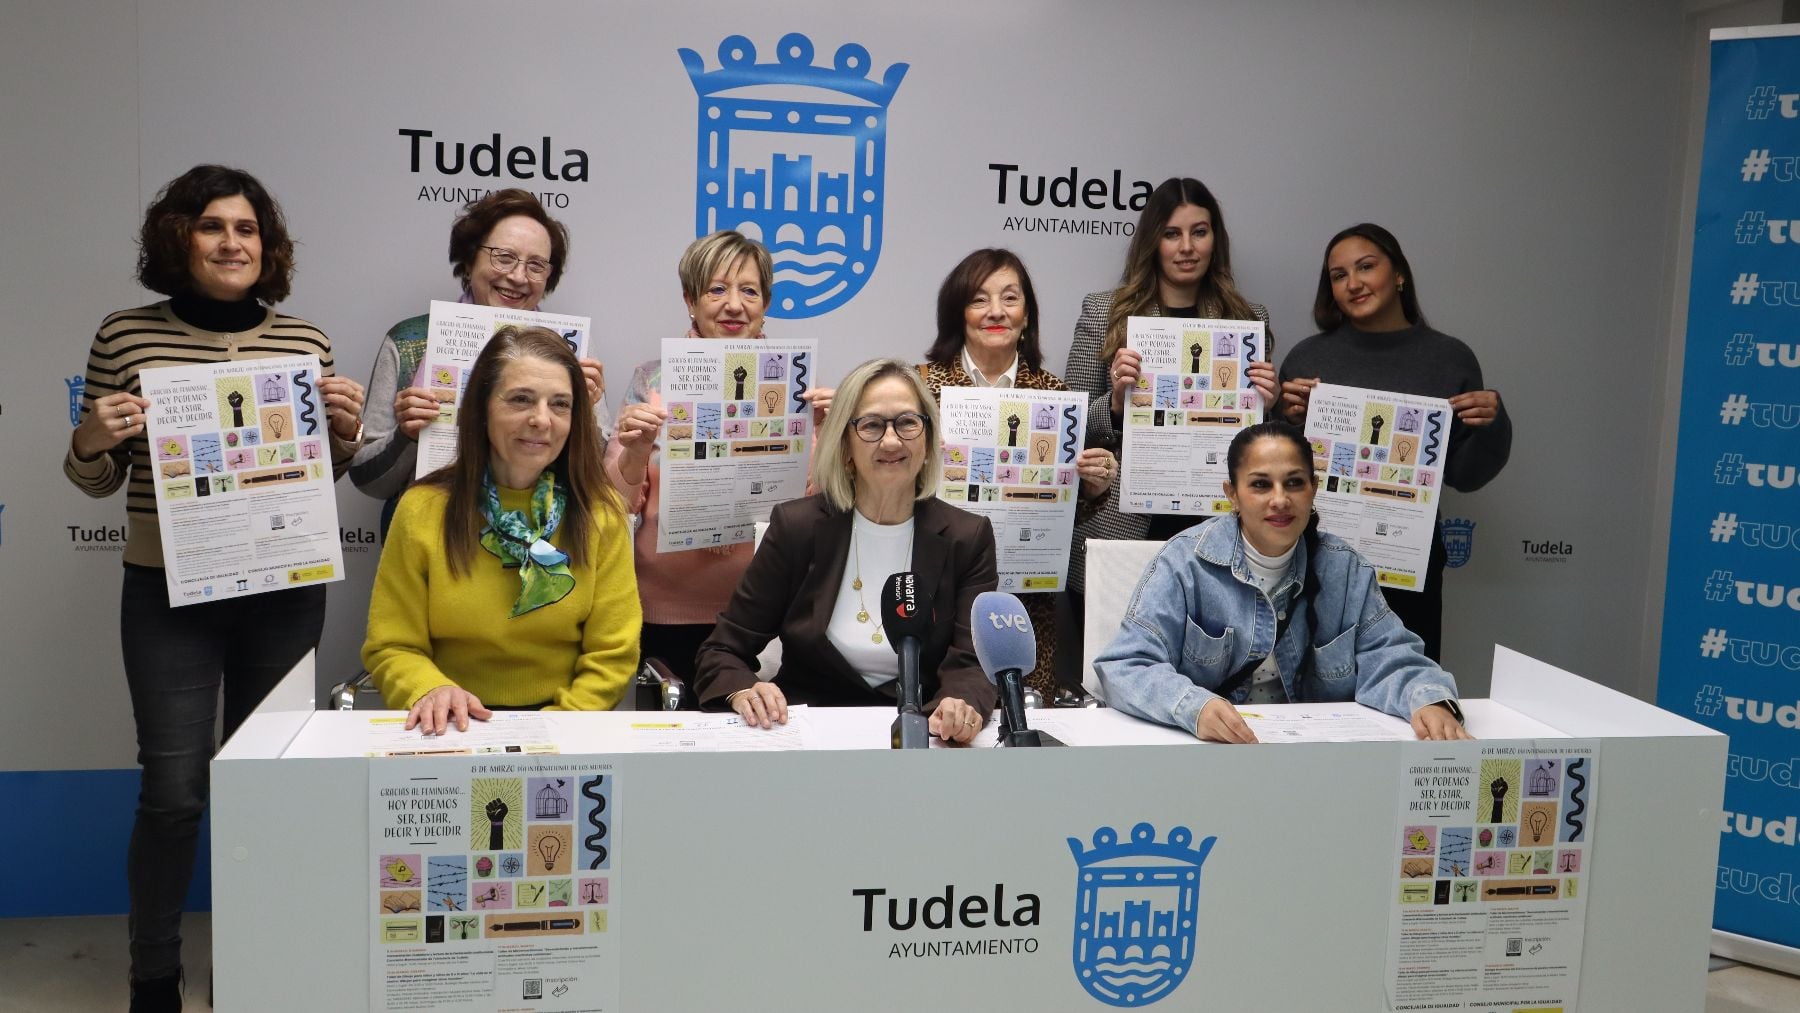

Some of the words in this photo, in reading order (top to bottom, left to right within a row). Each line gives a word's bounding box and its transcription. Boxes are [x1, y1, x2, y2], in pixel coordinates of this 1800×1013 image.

[398, 128, 588, 182] Tudela
[989, 164, 1154, 211] Tudela
[418, 186, 569, 208] AYUNTANTO
[1003, 217, 1135, 236] AYUNTAMIENTO
[174, 394, 208, 404] PODEMOS
[157, 416, 177, 426] DECIR
[186, 412, 213, 422] DECIDIR
[1714, 452, 1800, 488] #tu
[67, 526, 128, 542] Tudel
[340, 528, 376, 543] ela
[1522, 540, 1572, 554] Tudela
[988, 612, 1028, 632] tve
[471, 765, 477, 773] 8
[478, 764, 487, 773] DE
[490, 764, 515, 773] MARZO
[1726, 754, 1800, 789] tud
[1414, 778, 1430, 787] HOY
[1432, 777, 1470, 787] PODEMOS
[380, 787, 410, 797] GRACIAS
[411, 787, 420, 796] AL
[1420, 790, 1436, 800] SER,
[1438, 790, 1464, 800] ESTAR,
[388, 799, 410, 810] HOY
[411, 798, 458, 810] PODEMOS
[1410, 801, 1432, 811] DECIR
[1434, 801, 1439, 810] Y
[1440, 800, 1470, 811] DECIDIR
[397, 813, 417, 824] SER,
[420, 812, 451, 824] ESTAR,
[384, 826, 412, 838] DECIR
[415, 826, 420, 837] Y
[424, 825, 462, 837] DECIDIR
[1721, 810, 1798, 846] tud
[853, 884, 1040, 932] Tudela
[888, 938, 1038, 958] AYUNTAMIENTO
[544, 976, 578, 984] inscripción
